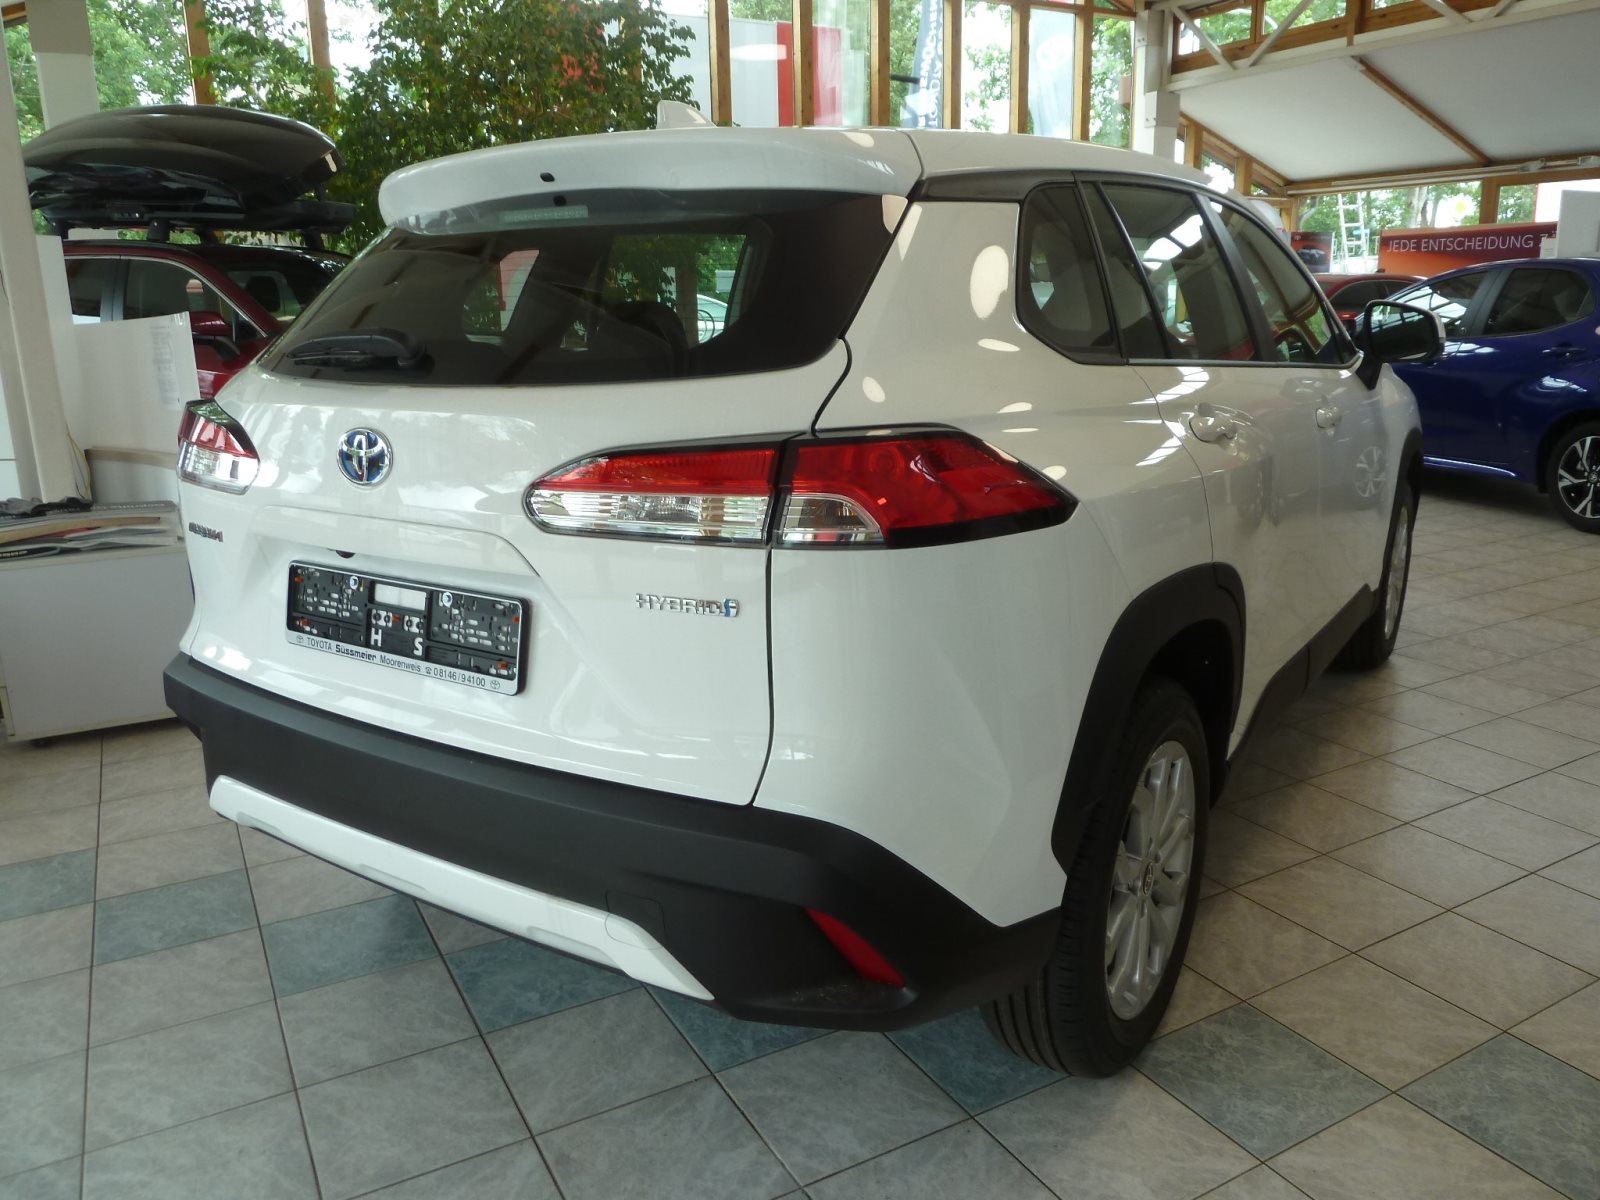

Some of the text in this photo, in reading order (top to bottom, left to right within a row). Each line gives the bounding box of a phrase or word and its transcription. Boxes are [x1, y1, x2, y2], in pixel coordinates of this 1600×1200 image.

[1387, 239, 1417, 253] JEDE
[1421, 234, 1534, 252] ENTSCHEIDUNG
[635, 592, 721, 616] HYBRID
[306, 636, 333, 652] TOYOTA
[379, 654, 421, 673] Moorenweis
